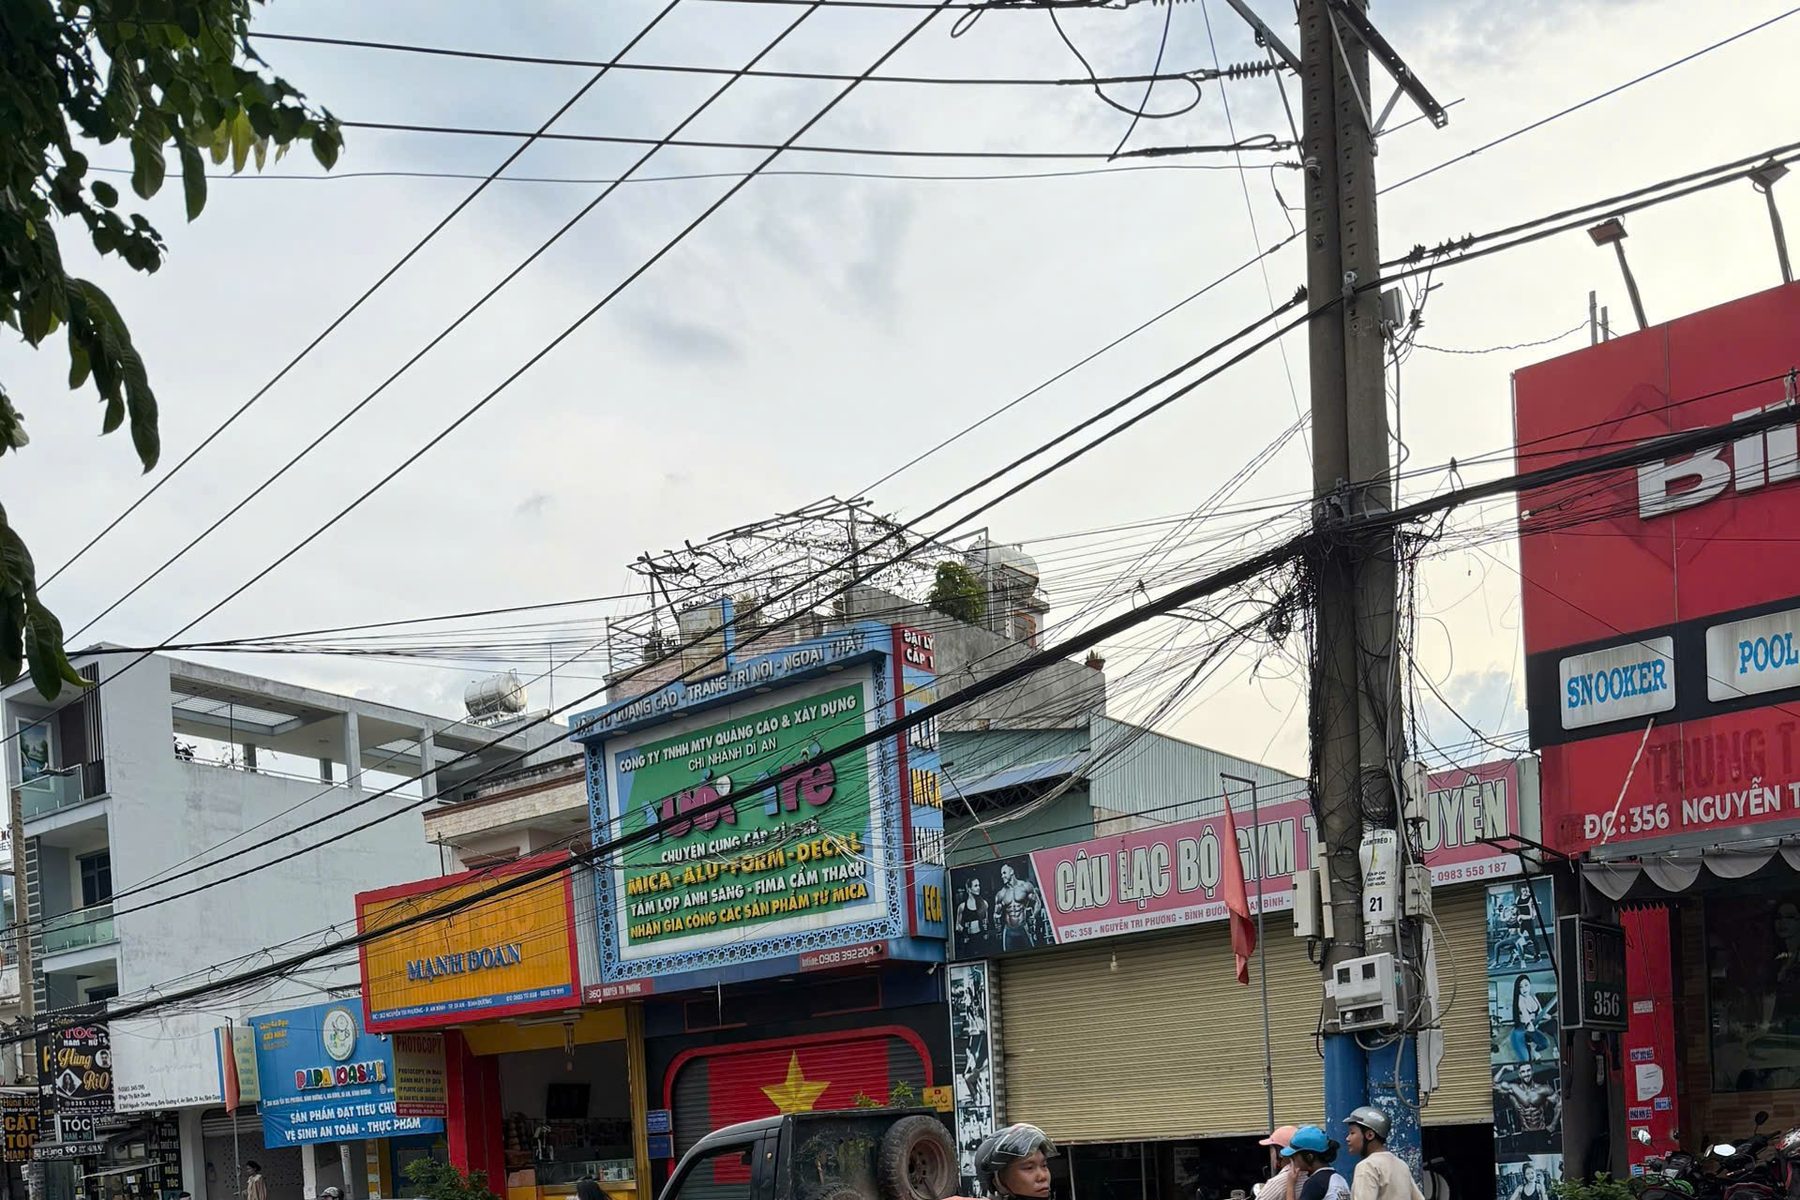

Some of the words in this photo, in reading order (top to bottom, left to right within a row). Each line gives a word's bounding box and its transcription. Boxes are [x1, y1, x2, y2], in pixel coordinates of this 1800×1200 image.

[1739, 632, 1799, 675] POOL
[687, 675, 728, 701] TRANG
[1567, 658, 1667, 709] SNOOKER
[620, 752, 646, 773] CÔNG
[647, 752, 660, 765] TY
[662, 745, 690, 760] TNHH
[691, 736, 713, 753] MTV
[715, 724, 754, 746] QUẢNG
[756, 717, 778, 735] CÁO
[794, 704, 818, 724] XÂY
[821, 694, 857, 718] DỰNG
[689, 758, 705, 772] CHI
[708, 746, 743, 765] NHÁNH
[761, 737, 777, 752] AN
[1683, 777, 1781, 826] NGUYỄN
[662, 842, 706, 863] CHUYÊN
[709, 835, 741, 853] CUNG
[1056, 849, 1112, 914] CÂU
[1117, 841, 1171, 911] LẠC
[1177, 824, 1220, 900] BỘ
[1437, 868, 1464, 882] 0983
[1468, 866, 1485, 878] 558
[1488, 862, 1507, 876] 187
[628, 871, 672, 896] MICA
[756, 876, 786, 895] FIMA
[664, 917, 683, 932] GIA
[686, 910, 717, 929] CÔNG
[720, 904, 742, 922] CÁC
[832, 883, 867, 903] MICA
[1131, 919, 1143, 929] TRI
[1264, 896, 1284, 908] BÌNH
[1370, 896, 1383, 912] 21
[406, 953, 463, 981] MẠNH
[819, 951, 840, 964] 0908
[1593, 990, 1620, 1016] 356
[396, 1036, 442, 1054] PHOTOCOPY
[58, 1047, 92, 1070] Hùng
[295, 1066, 334, 1090] PAPA
[4, 1113, 38, 1131] CẮT
[62, 1116, 91, 1131] TÓC
[337, 1106, 354, 1120] ĐẠT
[297, 1127, 317, 1141] SINH
[320, 1126, 332, 1137] AN
